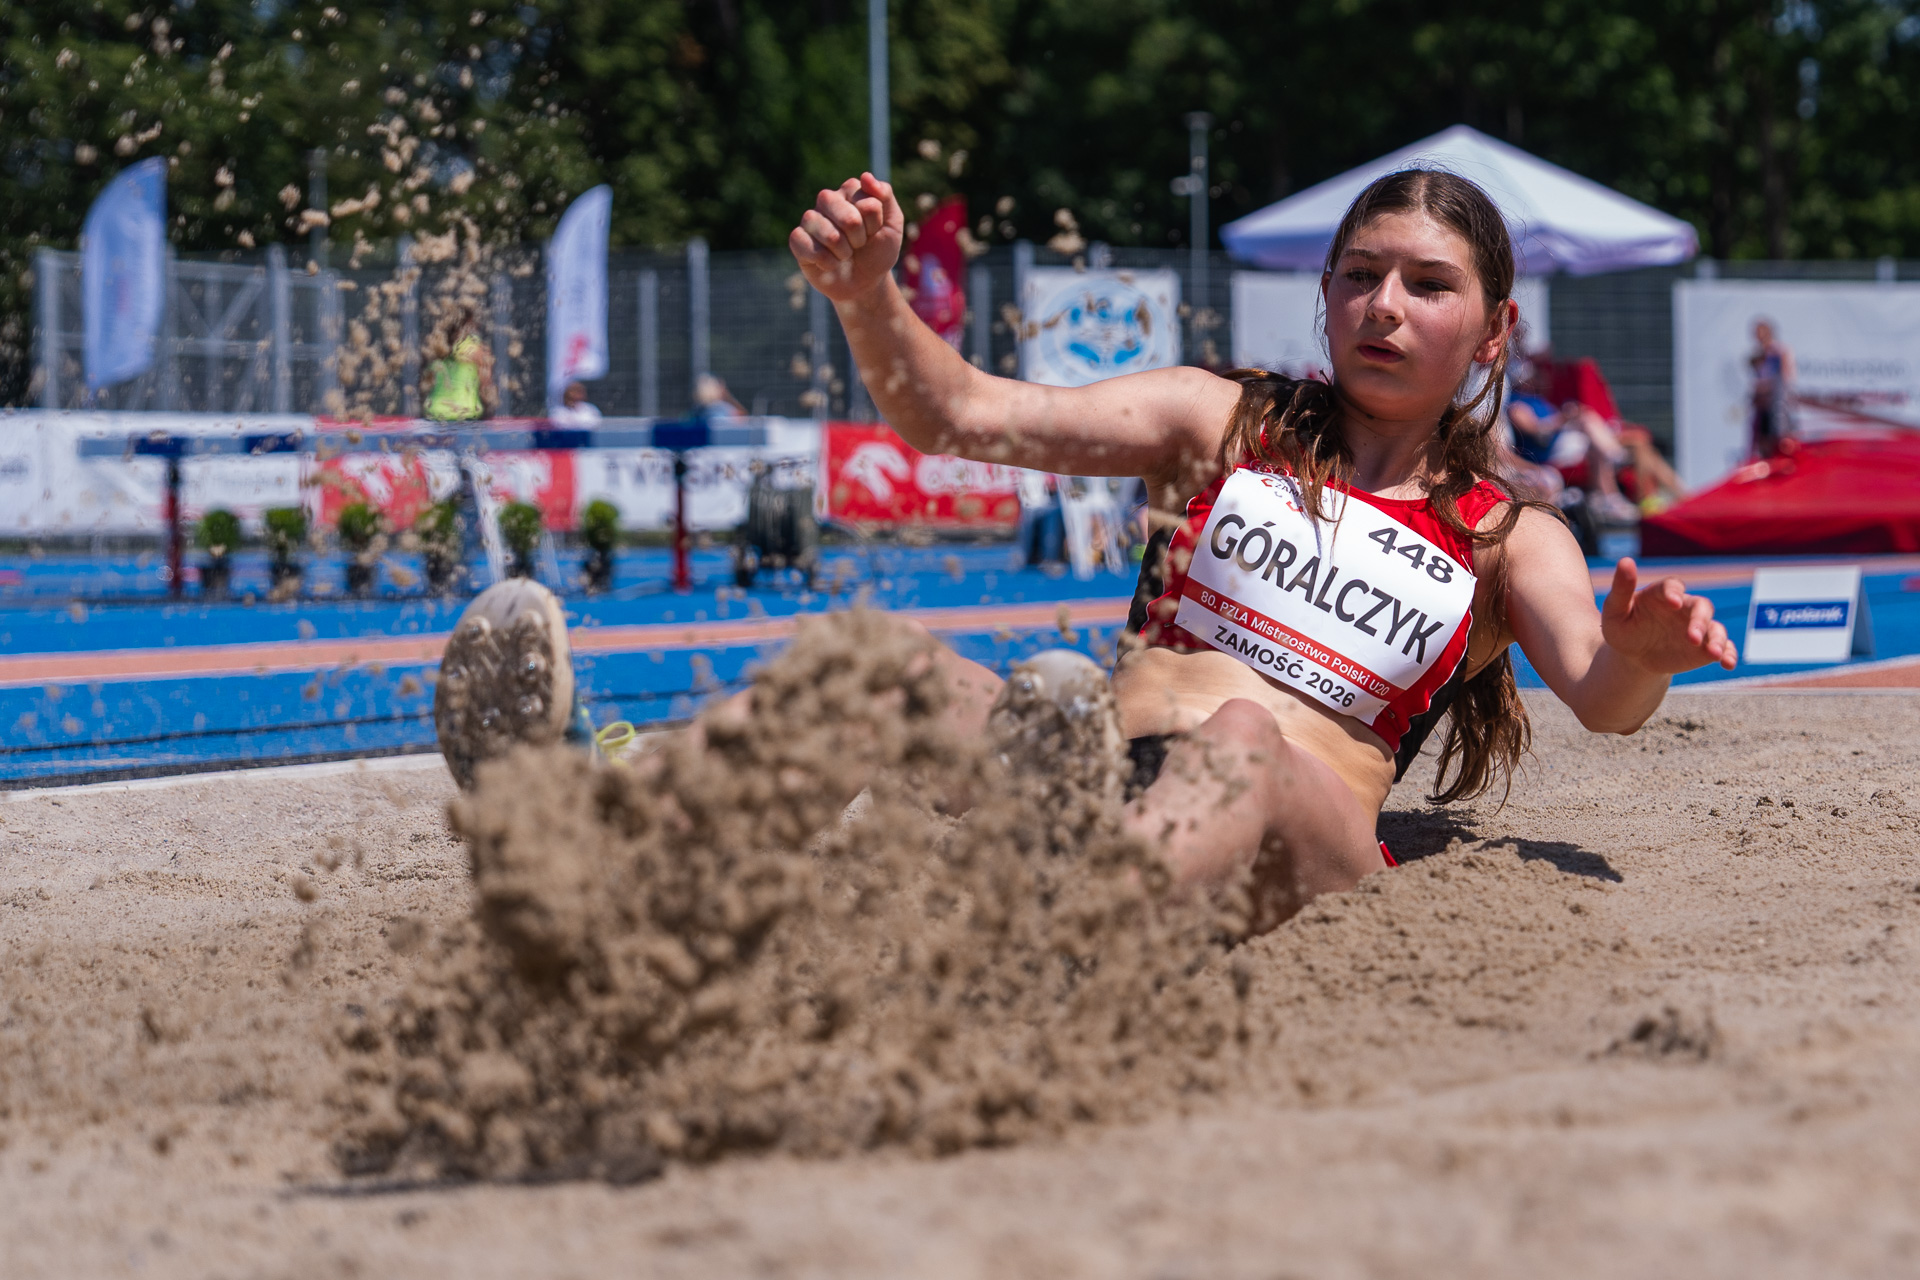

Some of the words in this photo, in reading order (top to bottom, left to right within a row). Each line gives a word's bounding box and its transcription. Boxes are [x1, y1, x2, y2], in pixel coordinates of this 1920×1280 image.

[1210, 514, 1444, 665] GÓRALCZYK
[1368, 527, 1453, 583] 448
[1200, 591, 1217, 609] 80.
[1220, 601, 1248, 624] PZLA
[1250, 616, 1330, 664] Mistrzostwa
[1331, 657, 1371, 686] Polski
[1369, 678, 1390, 697] U20
[1214, 625, 1304, 679] ZAMOŚĆ
[1305, 671, 1356, 708] 2026
